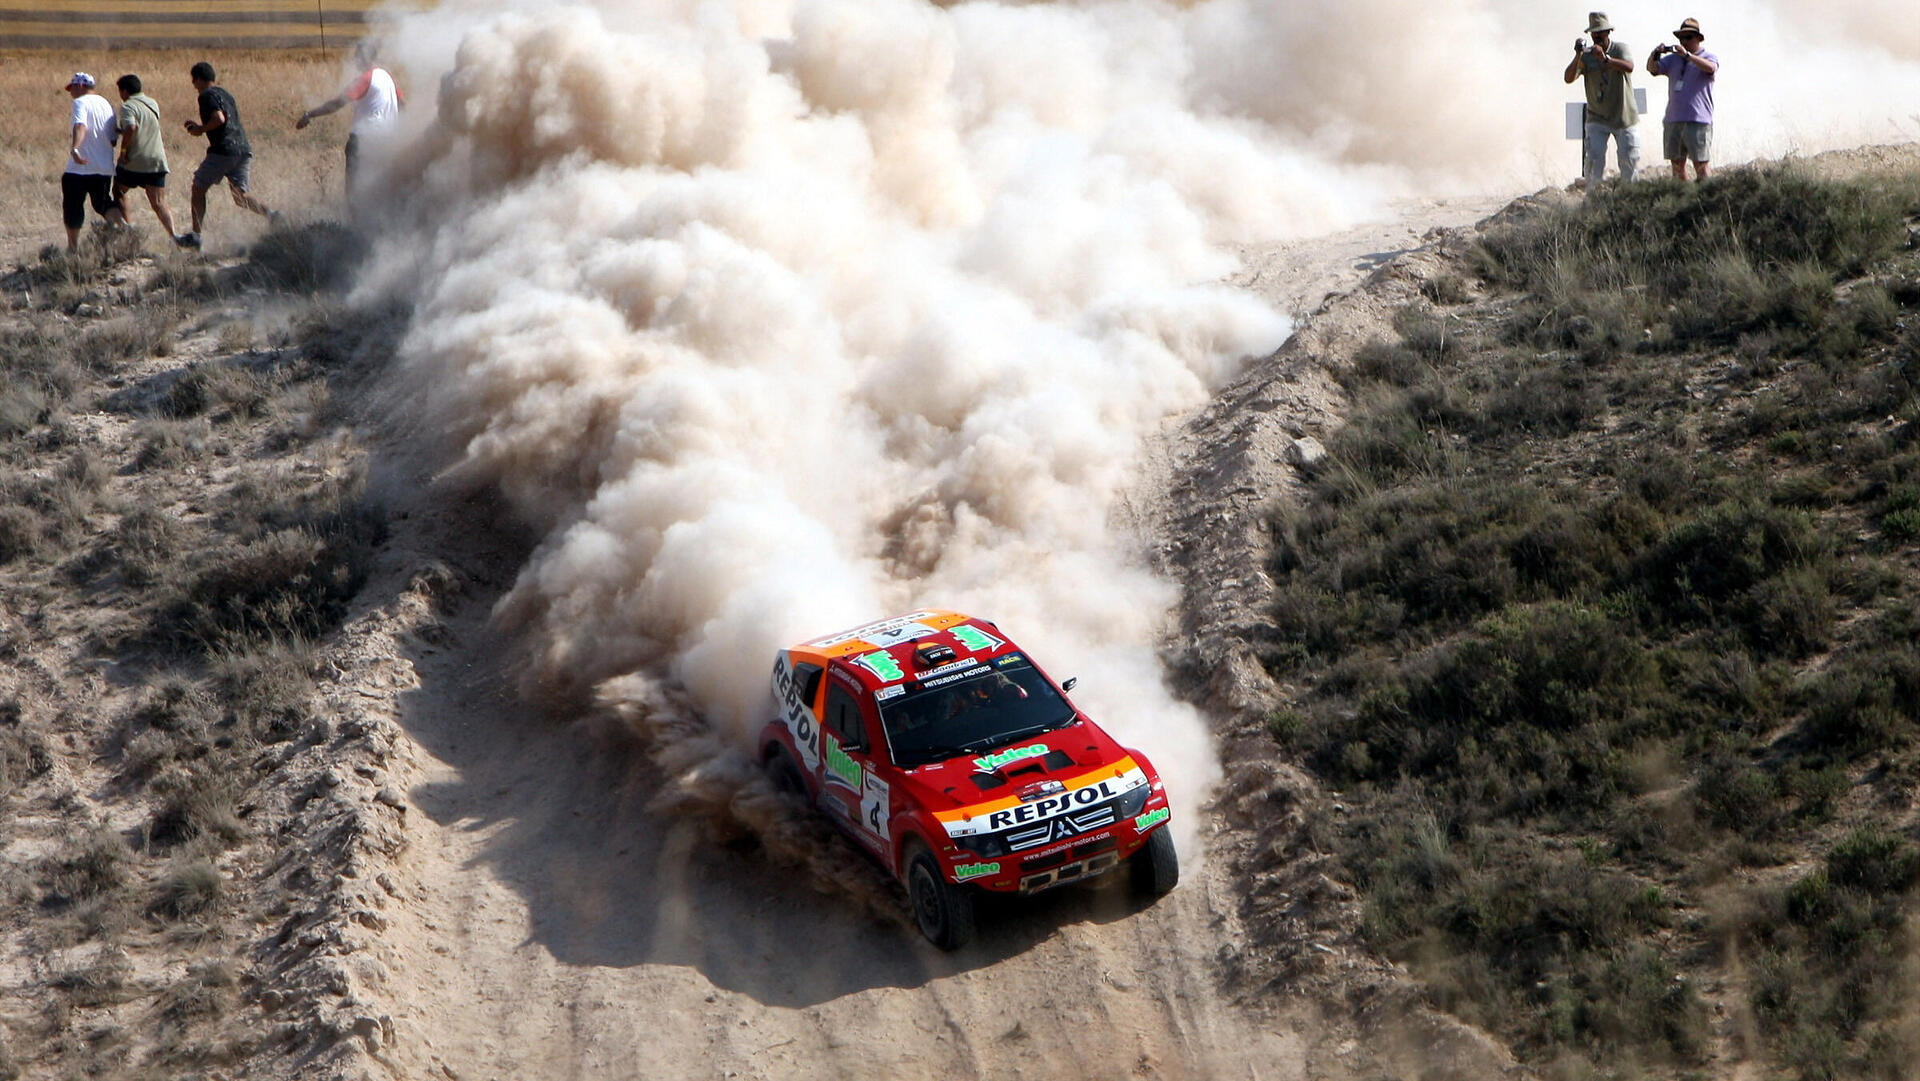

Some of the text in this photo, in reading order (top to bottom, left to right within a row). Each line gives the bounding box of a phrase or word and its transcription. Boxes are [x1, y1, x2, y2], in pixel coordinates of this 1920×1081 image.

[923, 665, 992, 688] MITSUBISHI MOTORS
[773, 657, 819, 756] REPSOL
[826, 733, 862, 790] Valeo
[972, 744, 1049, 769] Valeo
[870, 801, 881, 834] 4
[989, 782, 1117, 830] REPSOL
[1135, 807, 1169, 829] Valeo
[1023, 831, 1110, 861] www.mitsubishi-motors.com
[955, 861, 1000, 878] Valeo
